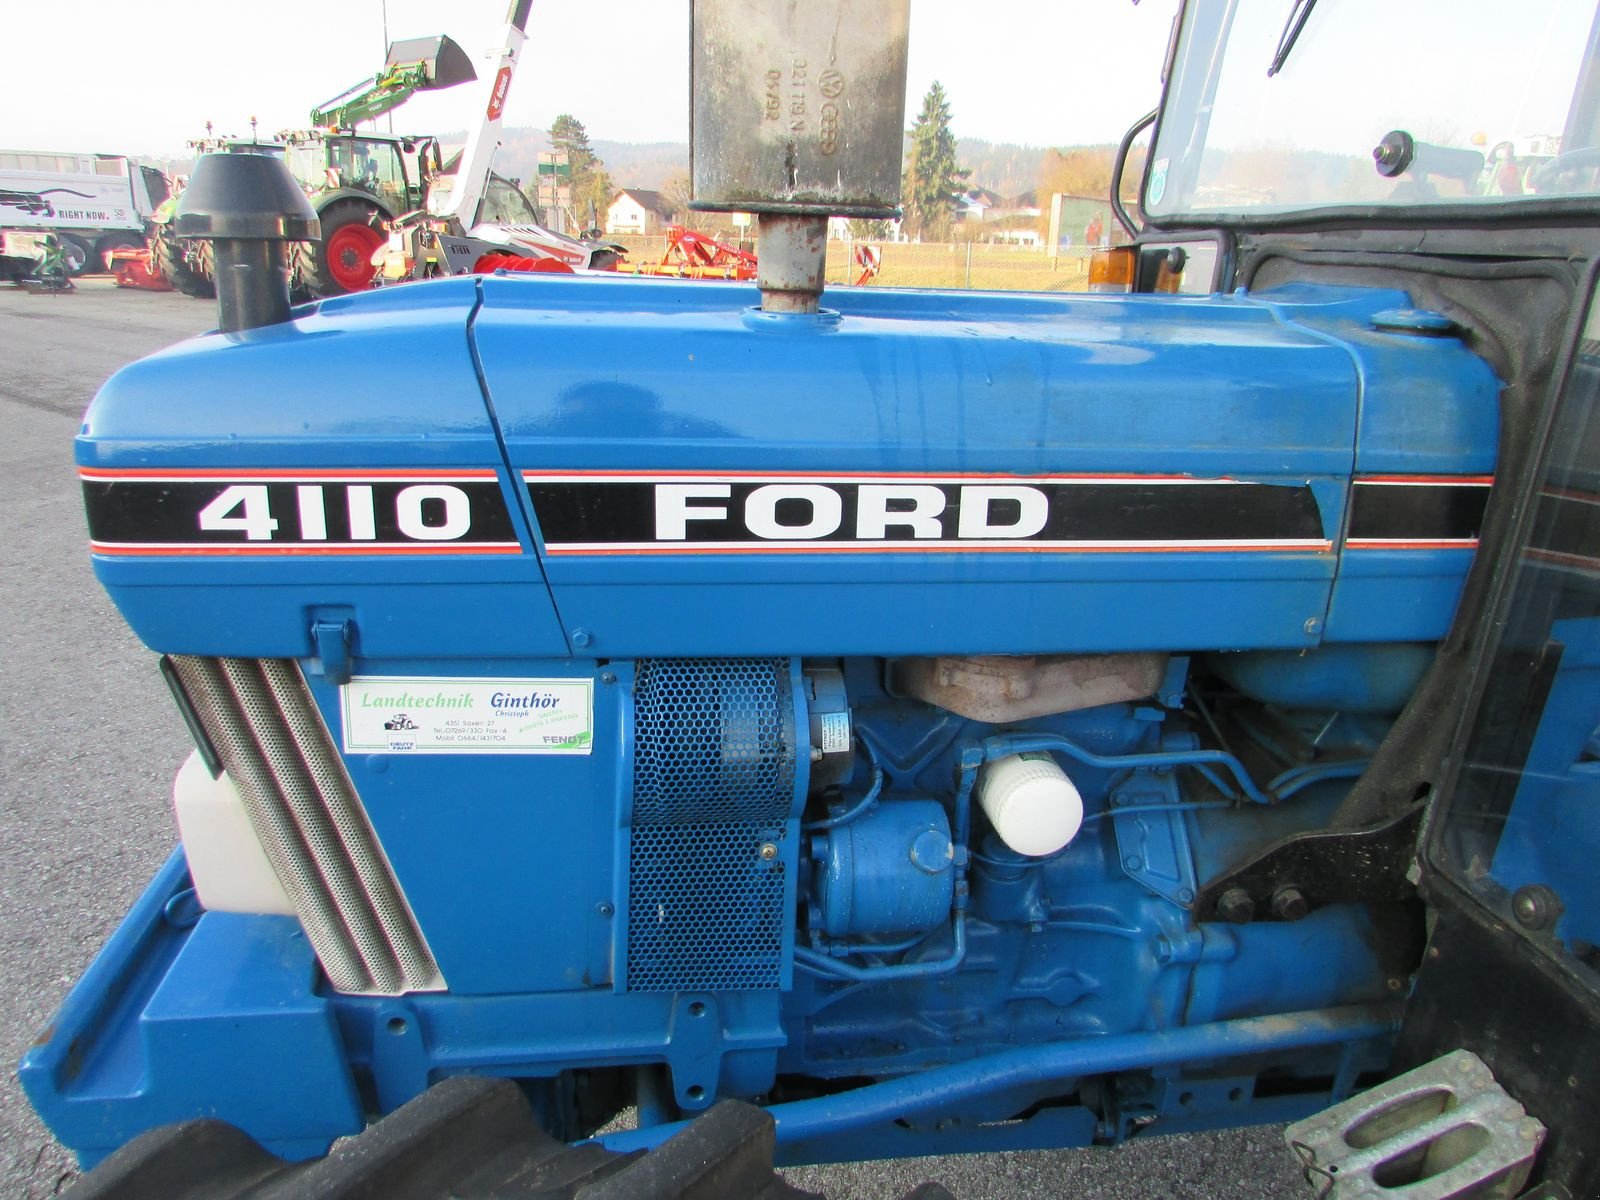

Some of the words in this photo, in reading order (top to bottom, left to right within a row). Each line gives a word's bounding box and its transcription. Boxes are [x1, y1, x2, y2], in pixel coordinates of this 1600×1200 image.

[59, 209, 84, 220] RIGHT
[199, 484, 471, 541] 4110
[654, 483, 1050, 540] FORD
[361, 692, 474, 708] Landtechnik
[490, 692, 560, 709] Ginthör
[495, 710, 529, 718] Christoph
[543, 736, 586, 744] FENDT
